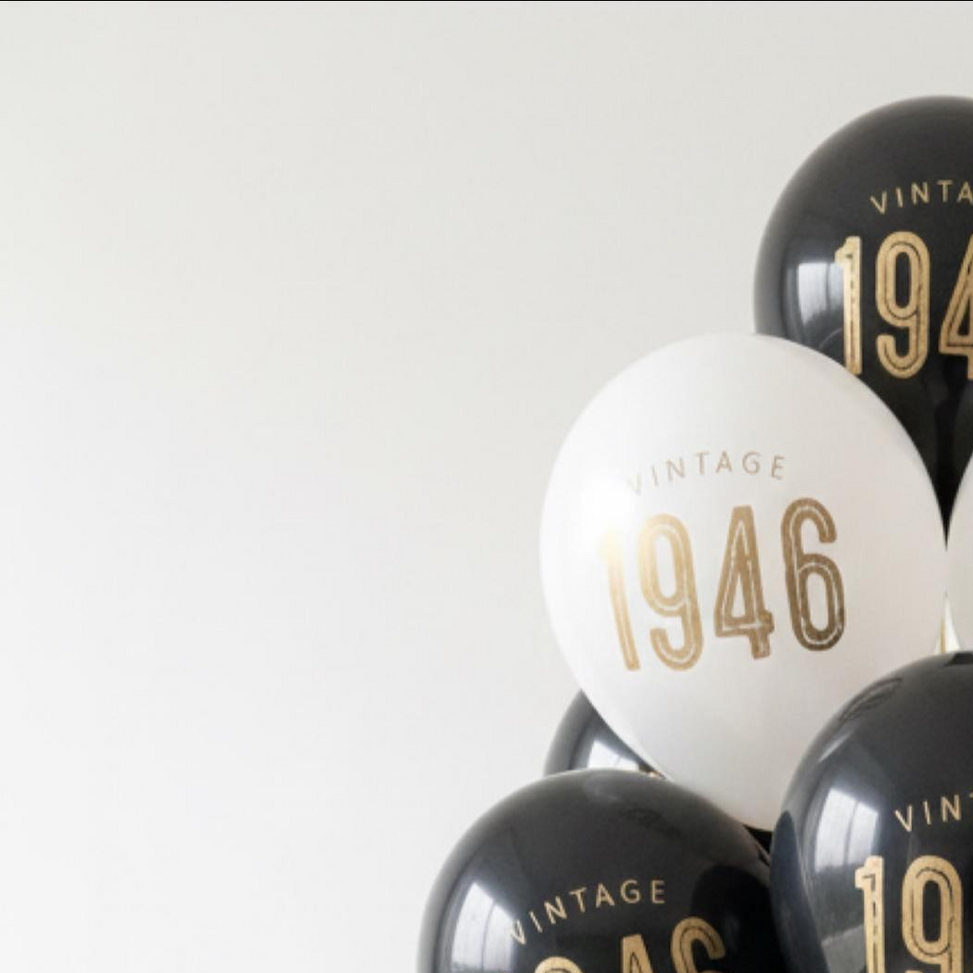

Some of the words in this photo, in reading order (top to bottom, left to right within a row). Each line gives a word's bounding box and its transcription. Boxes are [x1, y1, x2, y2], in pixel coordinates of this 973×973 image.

[626, 451, 785, 496] VINTAGE
[602, 497, 845, 671] 1946
[510, 879, 665, 945] VINTAGE
